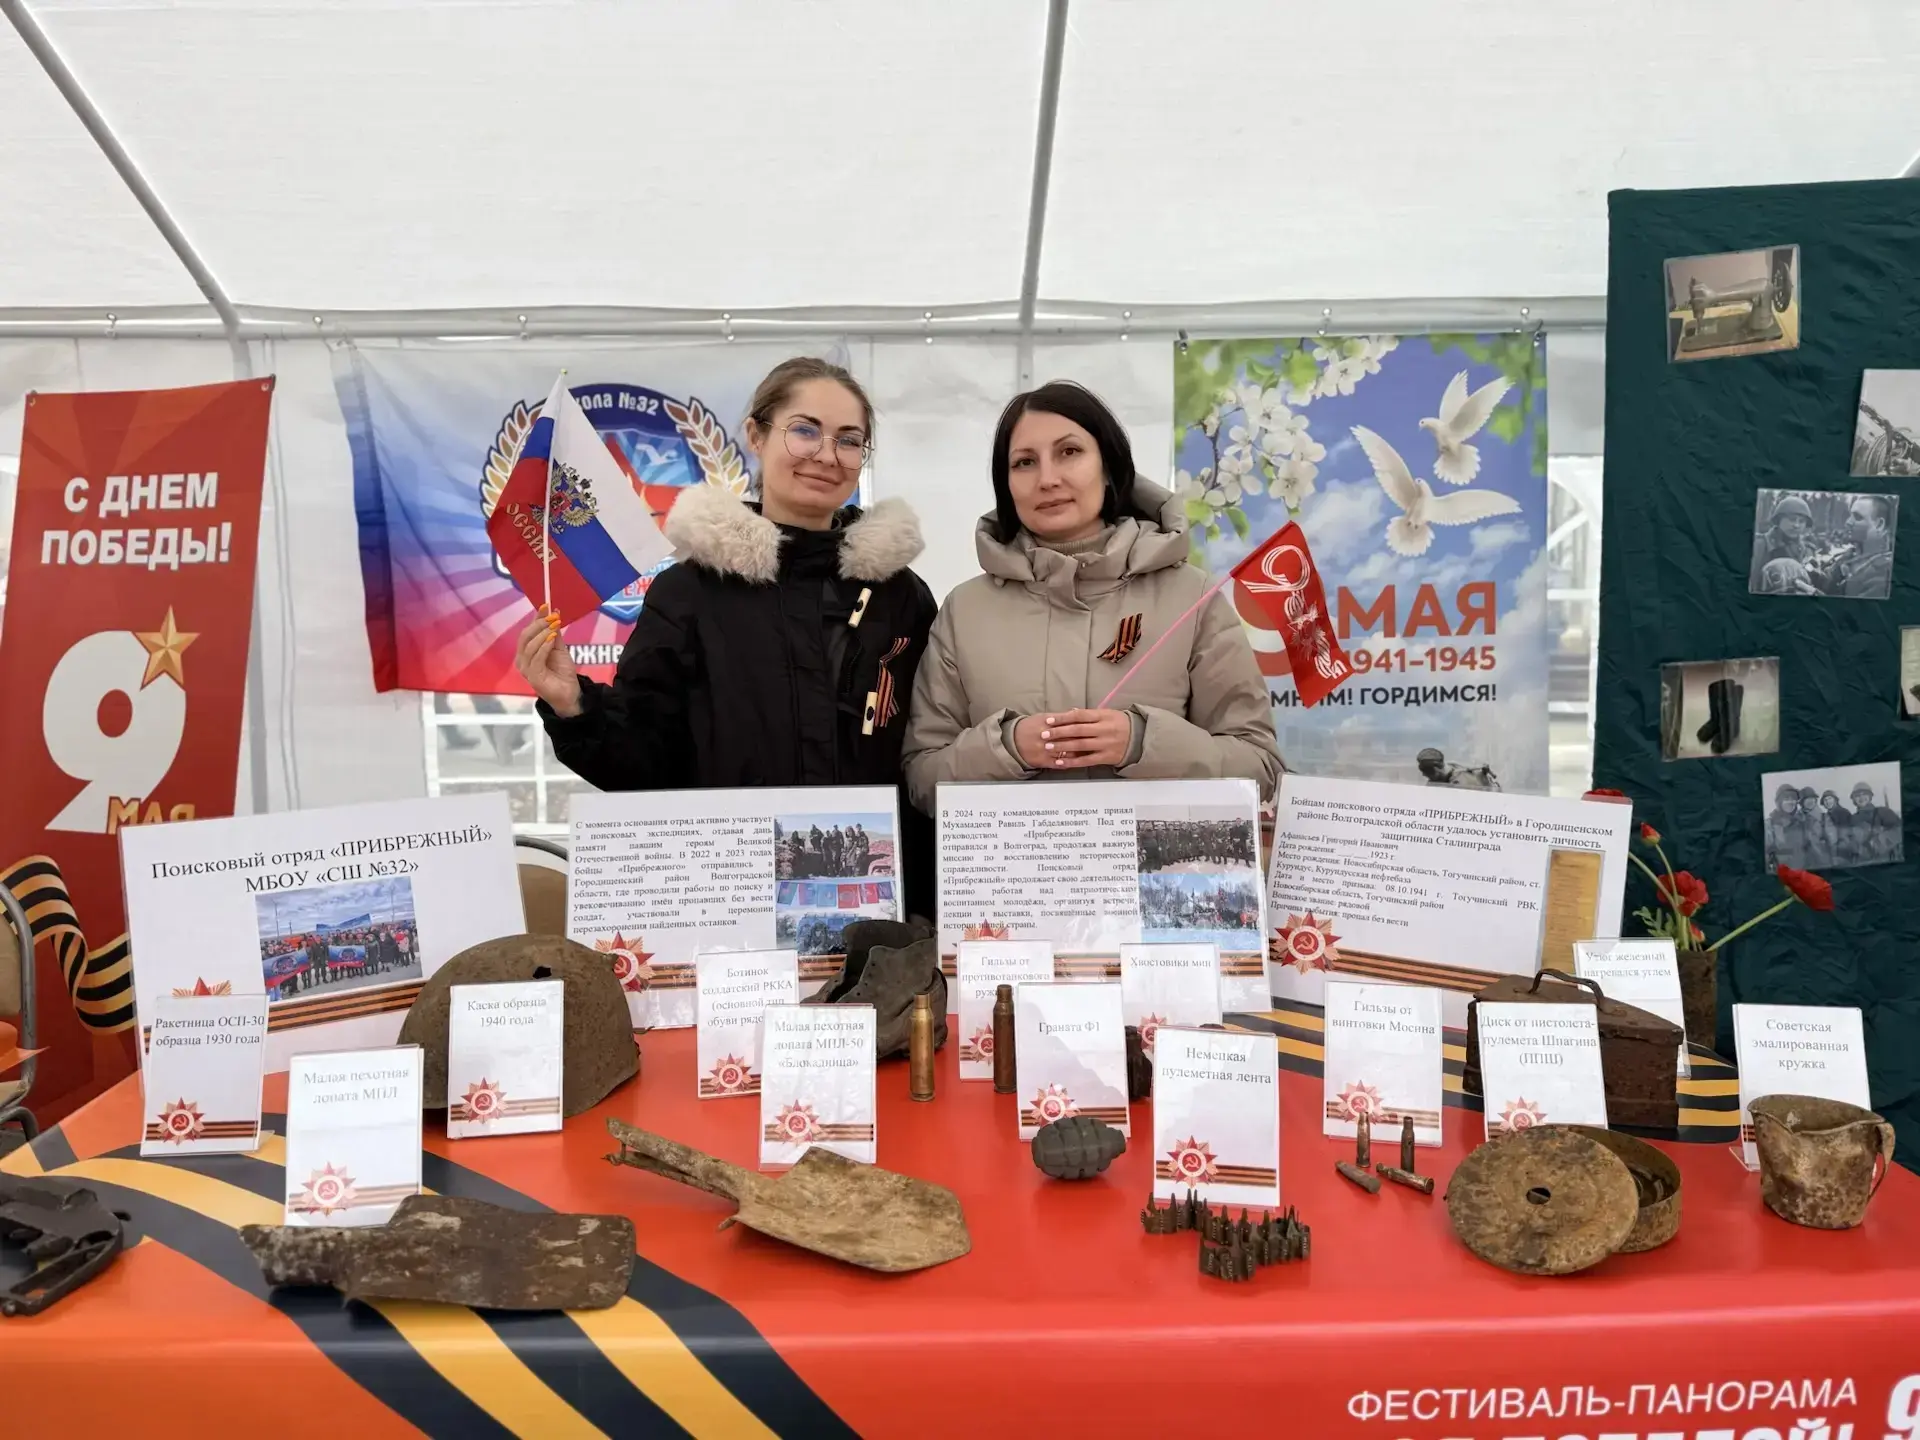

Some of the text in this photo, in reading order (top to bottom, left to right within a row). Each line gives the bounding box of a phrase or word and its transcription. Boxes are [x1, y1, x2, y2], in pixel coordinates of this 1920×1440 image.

[618, 392, 659, 416] №32
[64, 472, 218, 518] С ДНЕМ
[41, 523, 233, 571] ПОБЕДЫ!
[1337, 581, 1496, 640] МАЯ
[1344, 646, 1497, 675] 941–1945
[1360, 684, 1497, 707] ГОРДИМСЯ!
[42, 629, 187, 834] 9
[954, 810, 974, 818] 2024
[1291, 796, 1325, 808] Бойцам
[1327, 801, 1381, 812] поискового
[1384, 806, 1416, 816] отряда
[1418, 808, 1514, 826] «ПРИБРЕЖНЫЙ»
[1332, 812, 1402, 828] Волгоградской
[1405, 820, 1444, 832] области
[1446, 826, 1487, 836] удалось
[1436, 836, 1502, 852] Сталинграда
[151, 825, 493, 879] Поисковый отряд «ПРИБРЕЖНЫЙ»
[691, 850, 710, 858] 2022
[726, 849, 745, 858] 2023
[245, 859, 419, 894] МБОУ «СШ №32»
[1130, 956, 1212, 968] Хвостовики мин
[727, 968, 769, 978] Ботинок
[1642, 968, 1672, 979] углем
[702, 982, 793, 995] солдатский РККА
[467, 996, 547, 1011] Каска образца
[712, 998, 764, 1011] (основной
[1354, 1000, 1412, 1016] Гильзы от
[154, 1014, 264, 1029] Ракетница ОСП-30
[480, 1016, 534, 1028] 1940 года
[707, 1016, 738, 1028] обуви
[775, 1022, 864, 1032] Малая пехотная
[1038, 1021, 1100, 1034] Граната Ф1
[1332, 1019, 1435, 1034] винтовки Мосина
[1481, 1016, 1596, 1029] Диск от пистолета-
[1766, 1019, 1832, 1032] Советская
[156, 1034, 260, 1048] образца 1930 года
[774, 1038, 864, 1051] лопата МПЛ-50
[1483, 1035, 1597, 1048] пулемета Шпагина
[1752, 1038, 1849, 1052] эмалированная
[778, 1057, 859, 1068] «Блокадница»
[1186, 1048, 1246, 1063] Немецкая
[1519, 1052, 1564, 1066] (ППШ)
[1778, 1059, 1826, 1070] кружка
[303, 1067, 409, 1085] Малая пехотная
[1162, 1066, 1272, 1084] пулеметная лента
[312, 1086, 398, 1104] лопата МПЛ
[1347, 1377, 1858, 1421] ФЕСТИВАЛЬ-ПАНОРАМА
